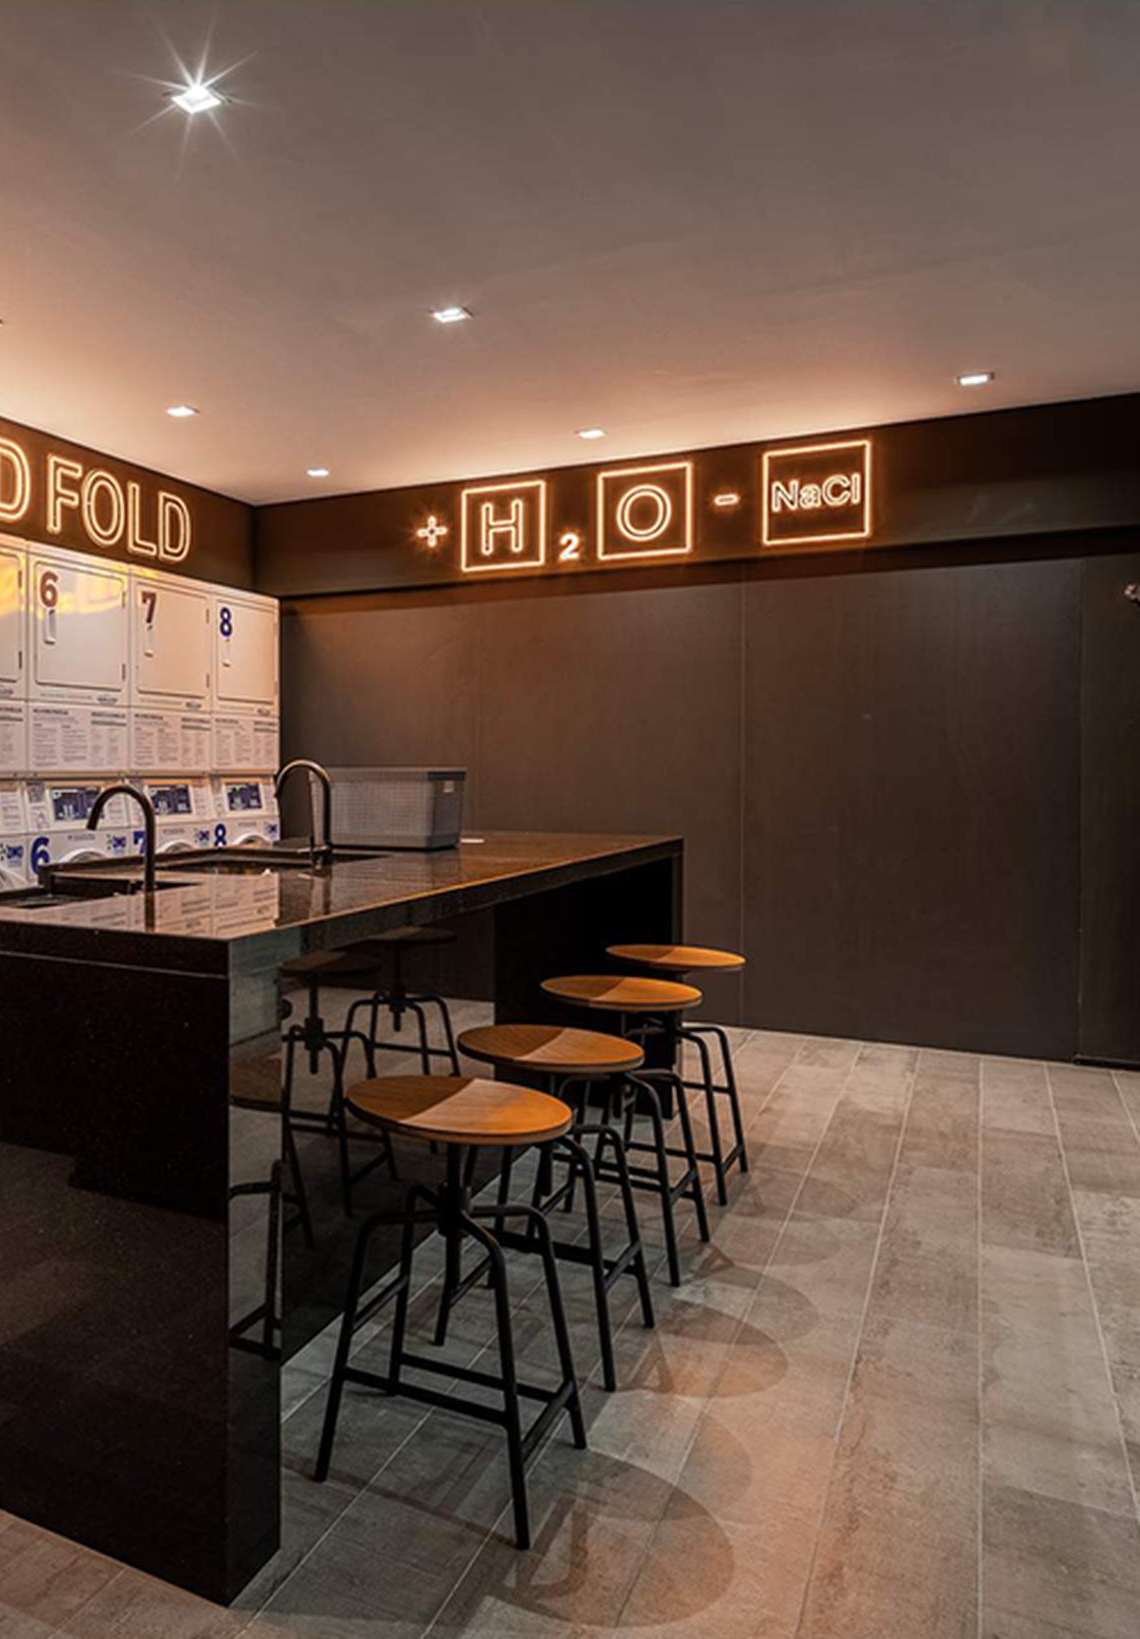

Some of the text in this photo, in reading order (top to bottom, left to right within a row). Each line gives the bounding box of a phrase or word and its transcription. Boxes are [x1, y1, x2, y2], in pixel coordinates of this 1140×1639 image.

[47, 453, 192, 563] FOLD
[771, 472, 862, 513] NaCl
[39, 571, 59, 608] 6
[141, 591, 157, 624] 7
[219, 606, 233, 638] 8
[133, 830, 147, 855] 7
[214, 823, 227, 847] 8
[31, 837, 50, 875] 6
